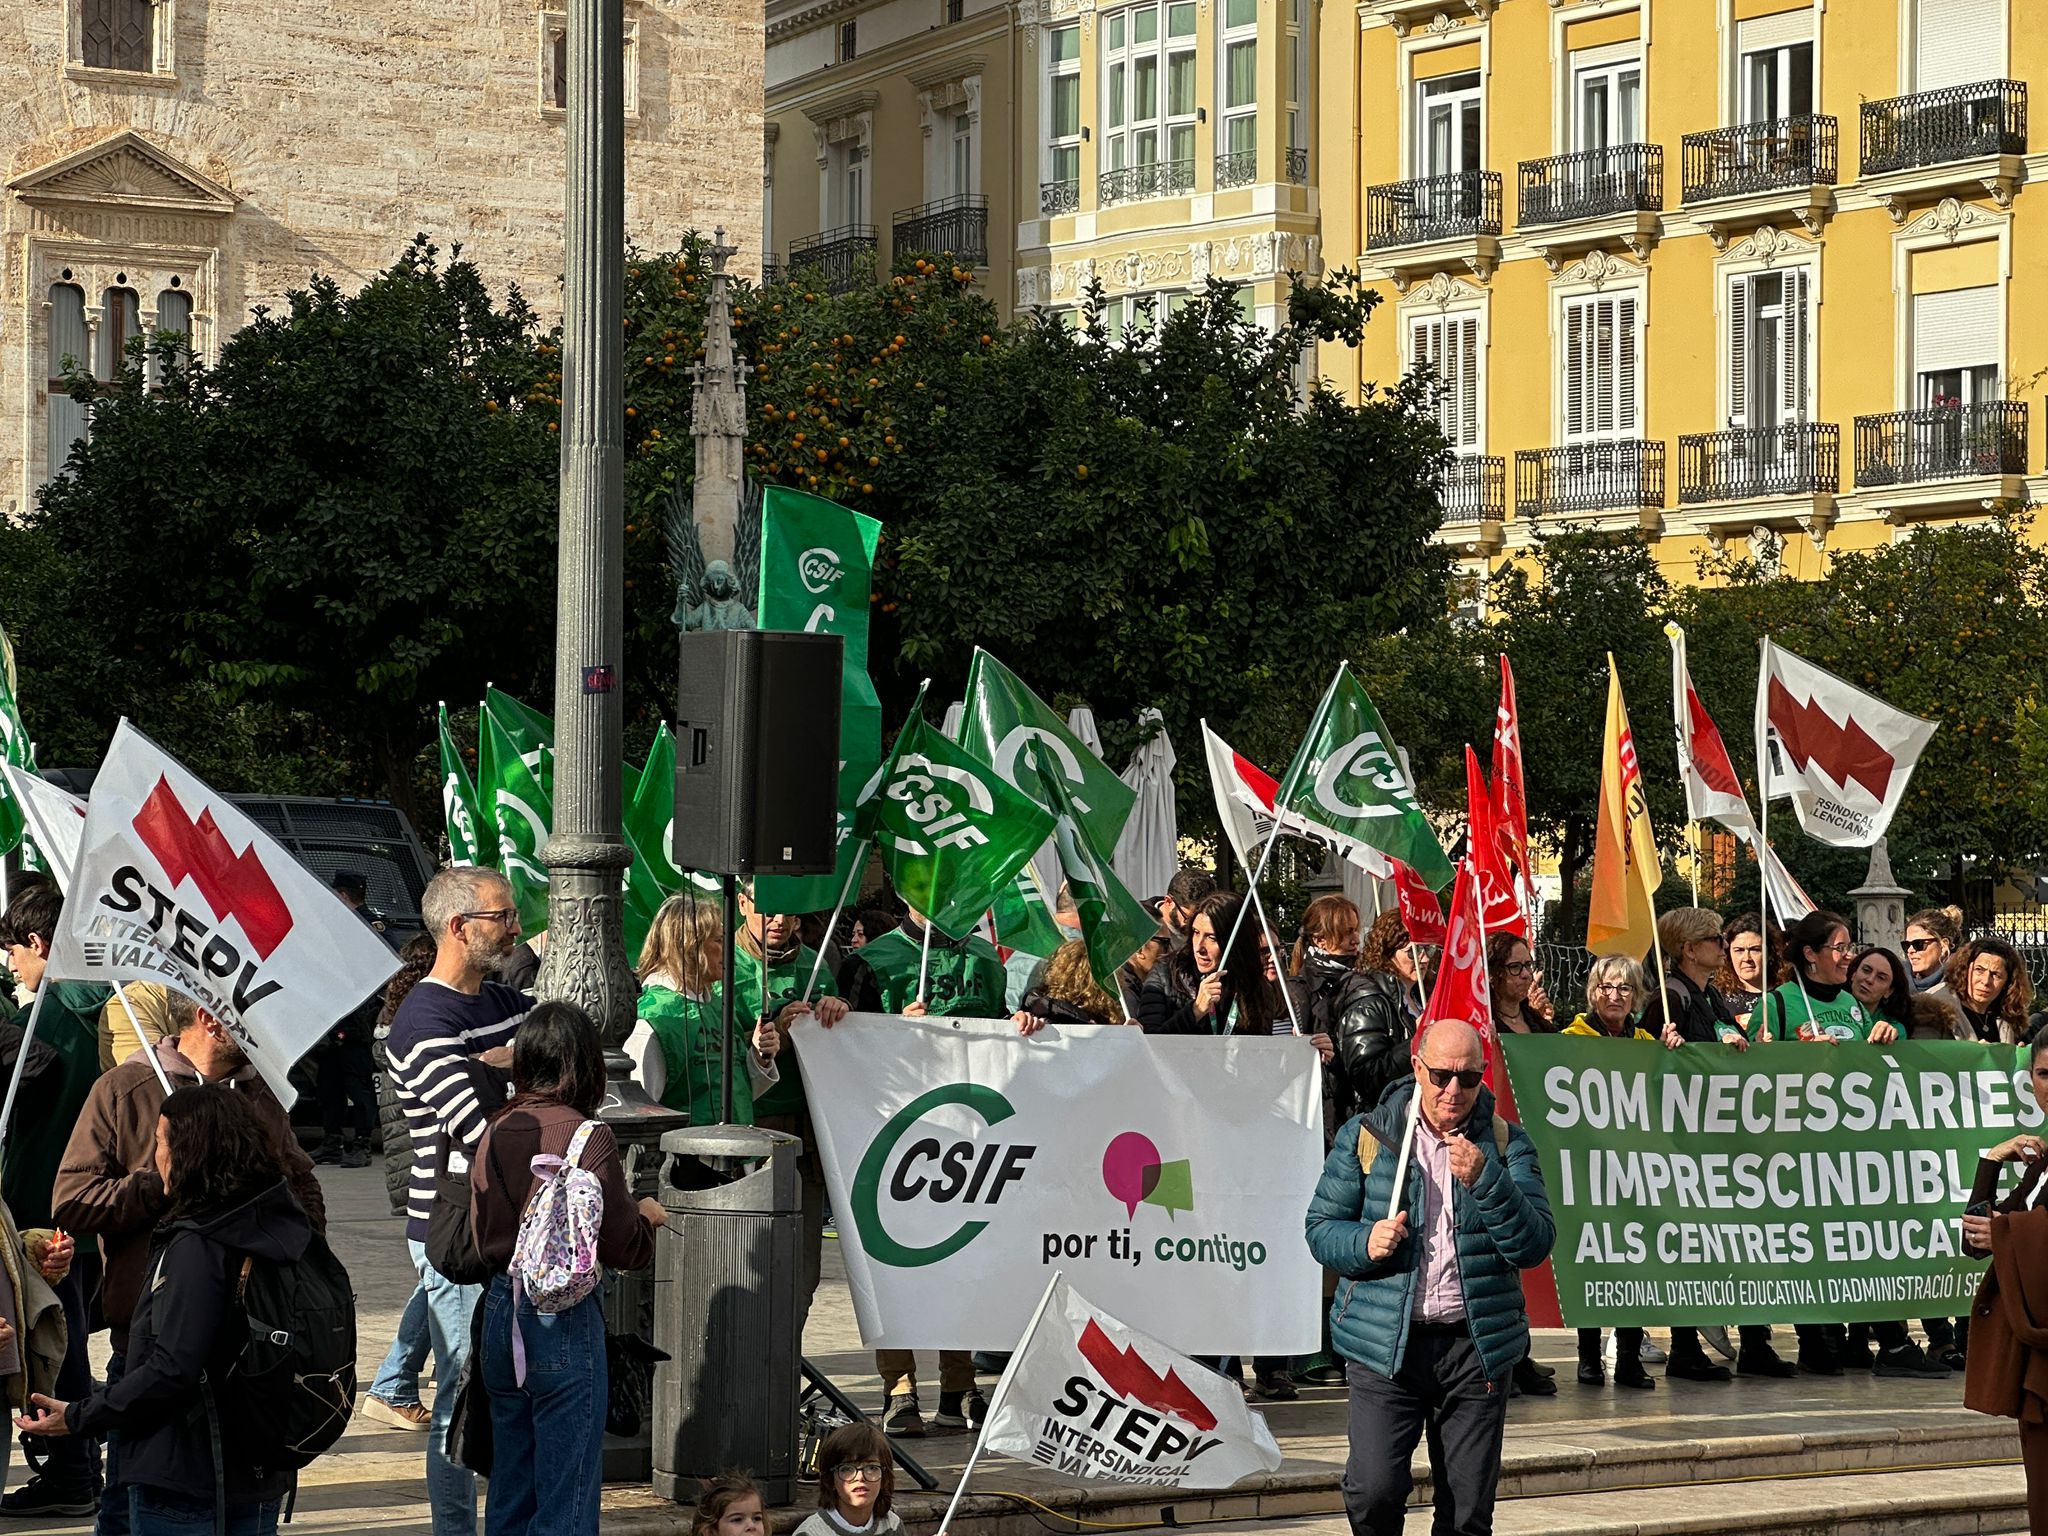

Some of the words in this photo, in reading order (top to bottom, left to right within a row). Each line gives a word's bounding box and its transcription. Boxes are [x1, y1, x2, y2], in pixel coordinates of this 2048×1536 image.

[804, 558, 846, 583] CSIF
[1349, 750, 1421, 811] CSI
[886, 774, 990, 851] CSIF
[1810, 807, 1870, 841] LENCIANA
[1815, 797, 1875, 831] RSINDICAL
[99, 865, 284, 1016] STEPV
[1544, 1065, 1651, 1132] SOM
[1661, 1054, 2046, 1134] NECESSÀRIES
[889, 1137, 1038, 1205] CSIF
[1559, 1149, 1575, 1206] I
[1589, 1148, 2029, 1209] IMPRESCINDIBL
[1042, 1233, 1098, 1265] por
[1107, 1228, 1142, 1267] ti,
[1154, 1233, 1267, 1272] contigo
[1575, 1222, 1647, 1264] ALS
[1657, 1222, 1814, 1264] CENTRES
[1584, 1280, 1664, 1307] PERSONAL
[1666, 1273, 1735, 1306] D'ATENCIÓ
[1740, 1279, 1816, 1306] EDUCATIVA
[1818, 1279, 1825, 1304] I
[1828, 1267, 1954, 1304] D'ADMINISTRACIÓ
[1956, 1273, 1962, 1297] I
[1964, 1272, 1986, 1297] SE
[1042, 1417, 1191, 1475] INTERSINDICAL
[1052, 1375, 1225, 1463] STEPV
